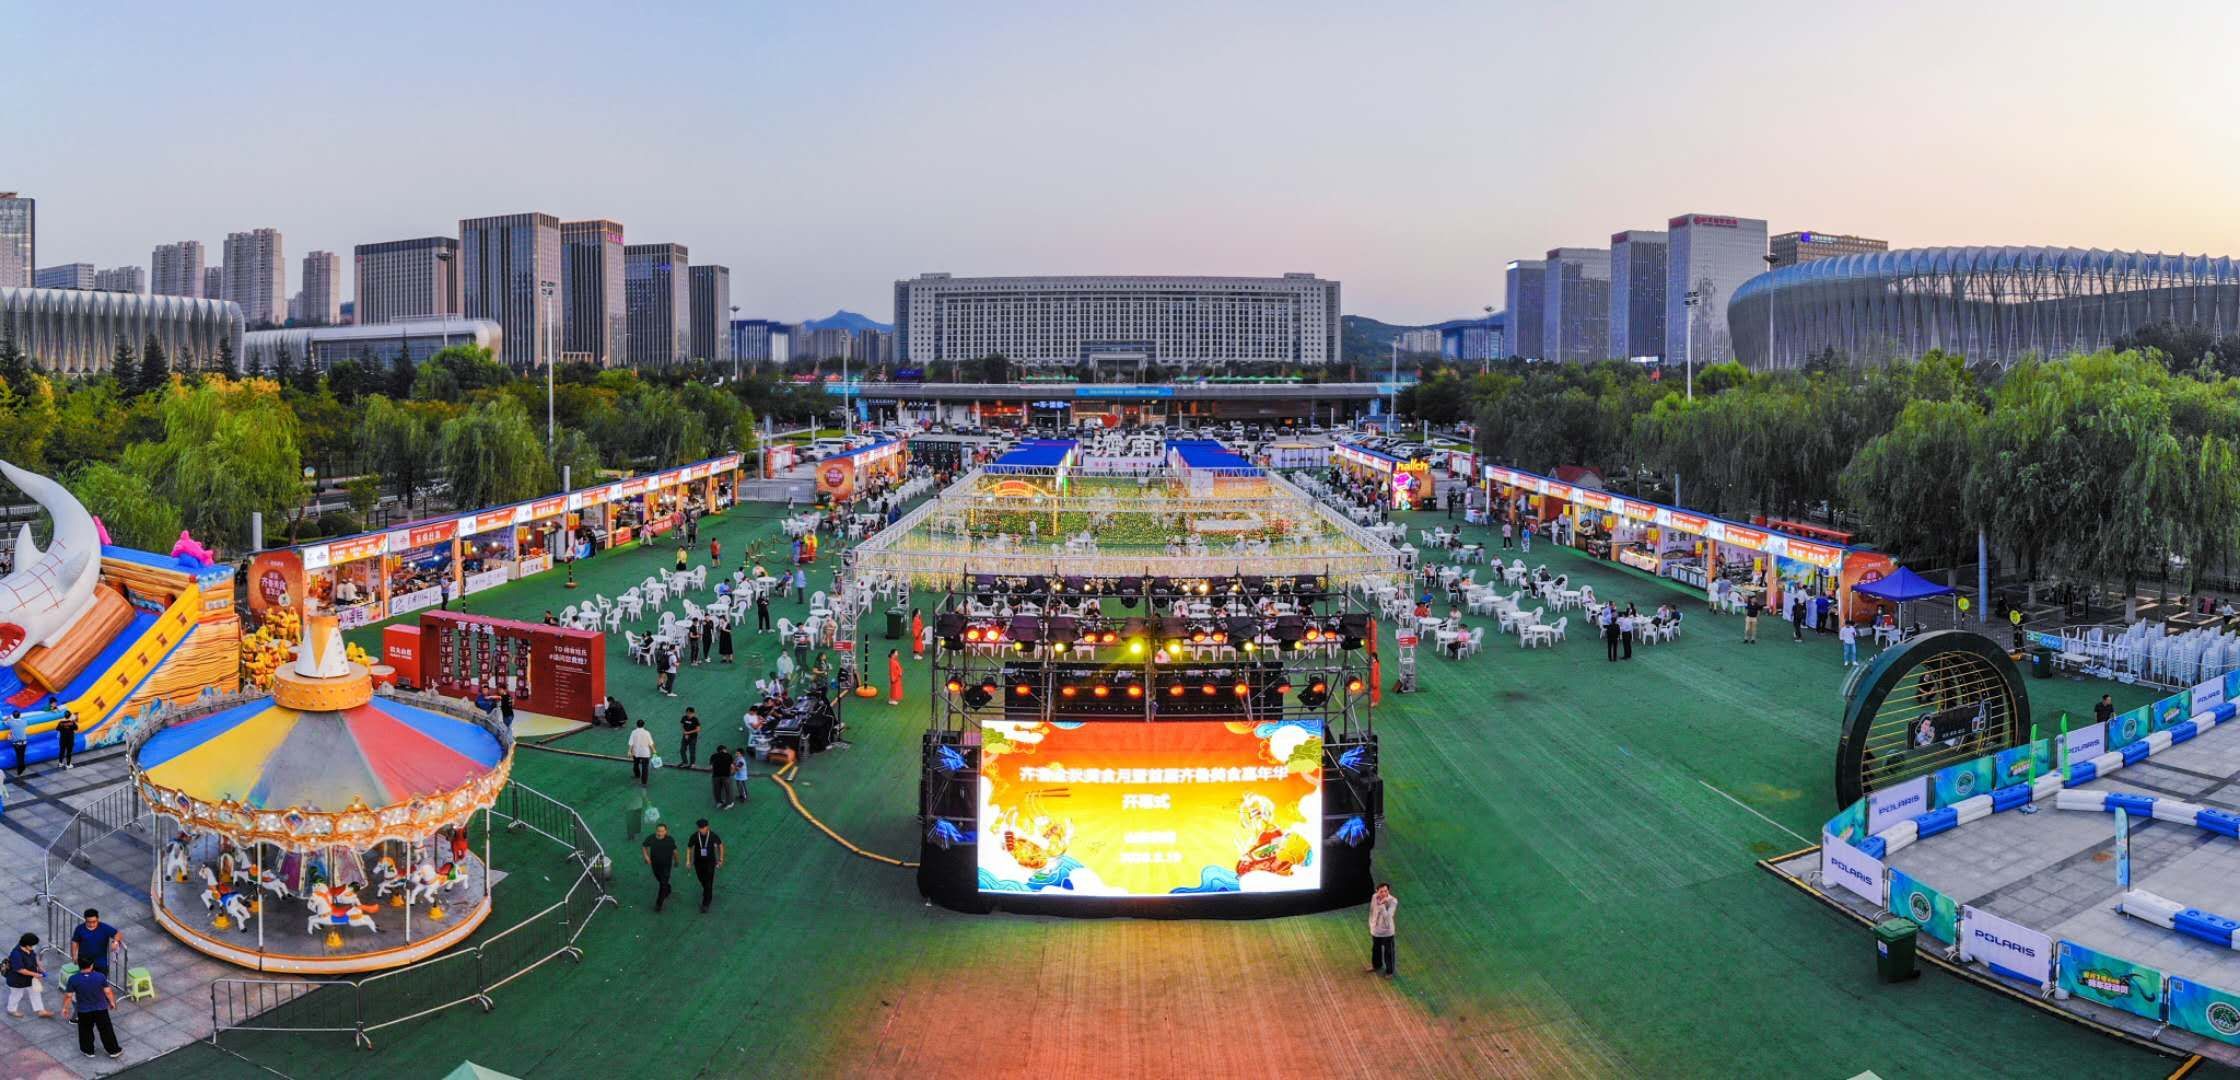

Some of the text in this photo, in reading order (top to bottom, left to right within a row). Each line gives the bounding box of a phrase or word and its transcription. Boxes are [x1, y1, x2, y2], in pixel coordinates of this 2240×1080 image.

[1879, 794, 1920, 815] POLARIS
[1831, 857, 1873, 886] POLARIS
[1975, 928, 2036, 959] POLARIS
